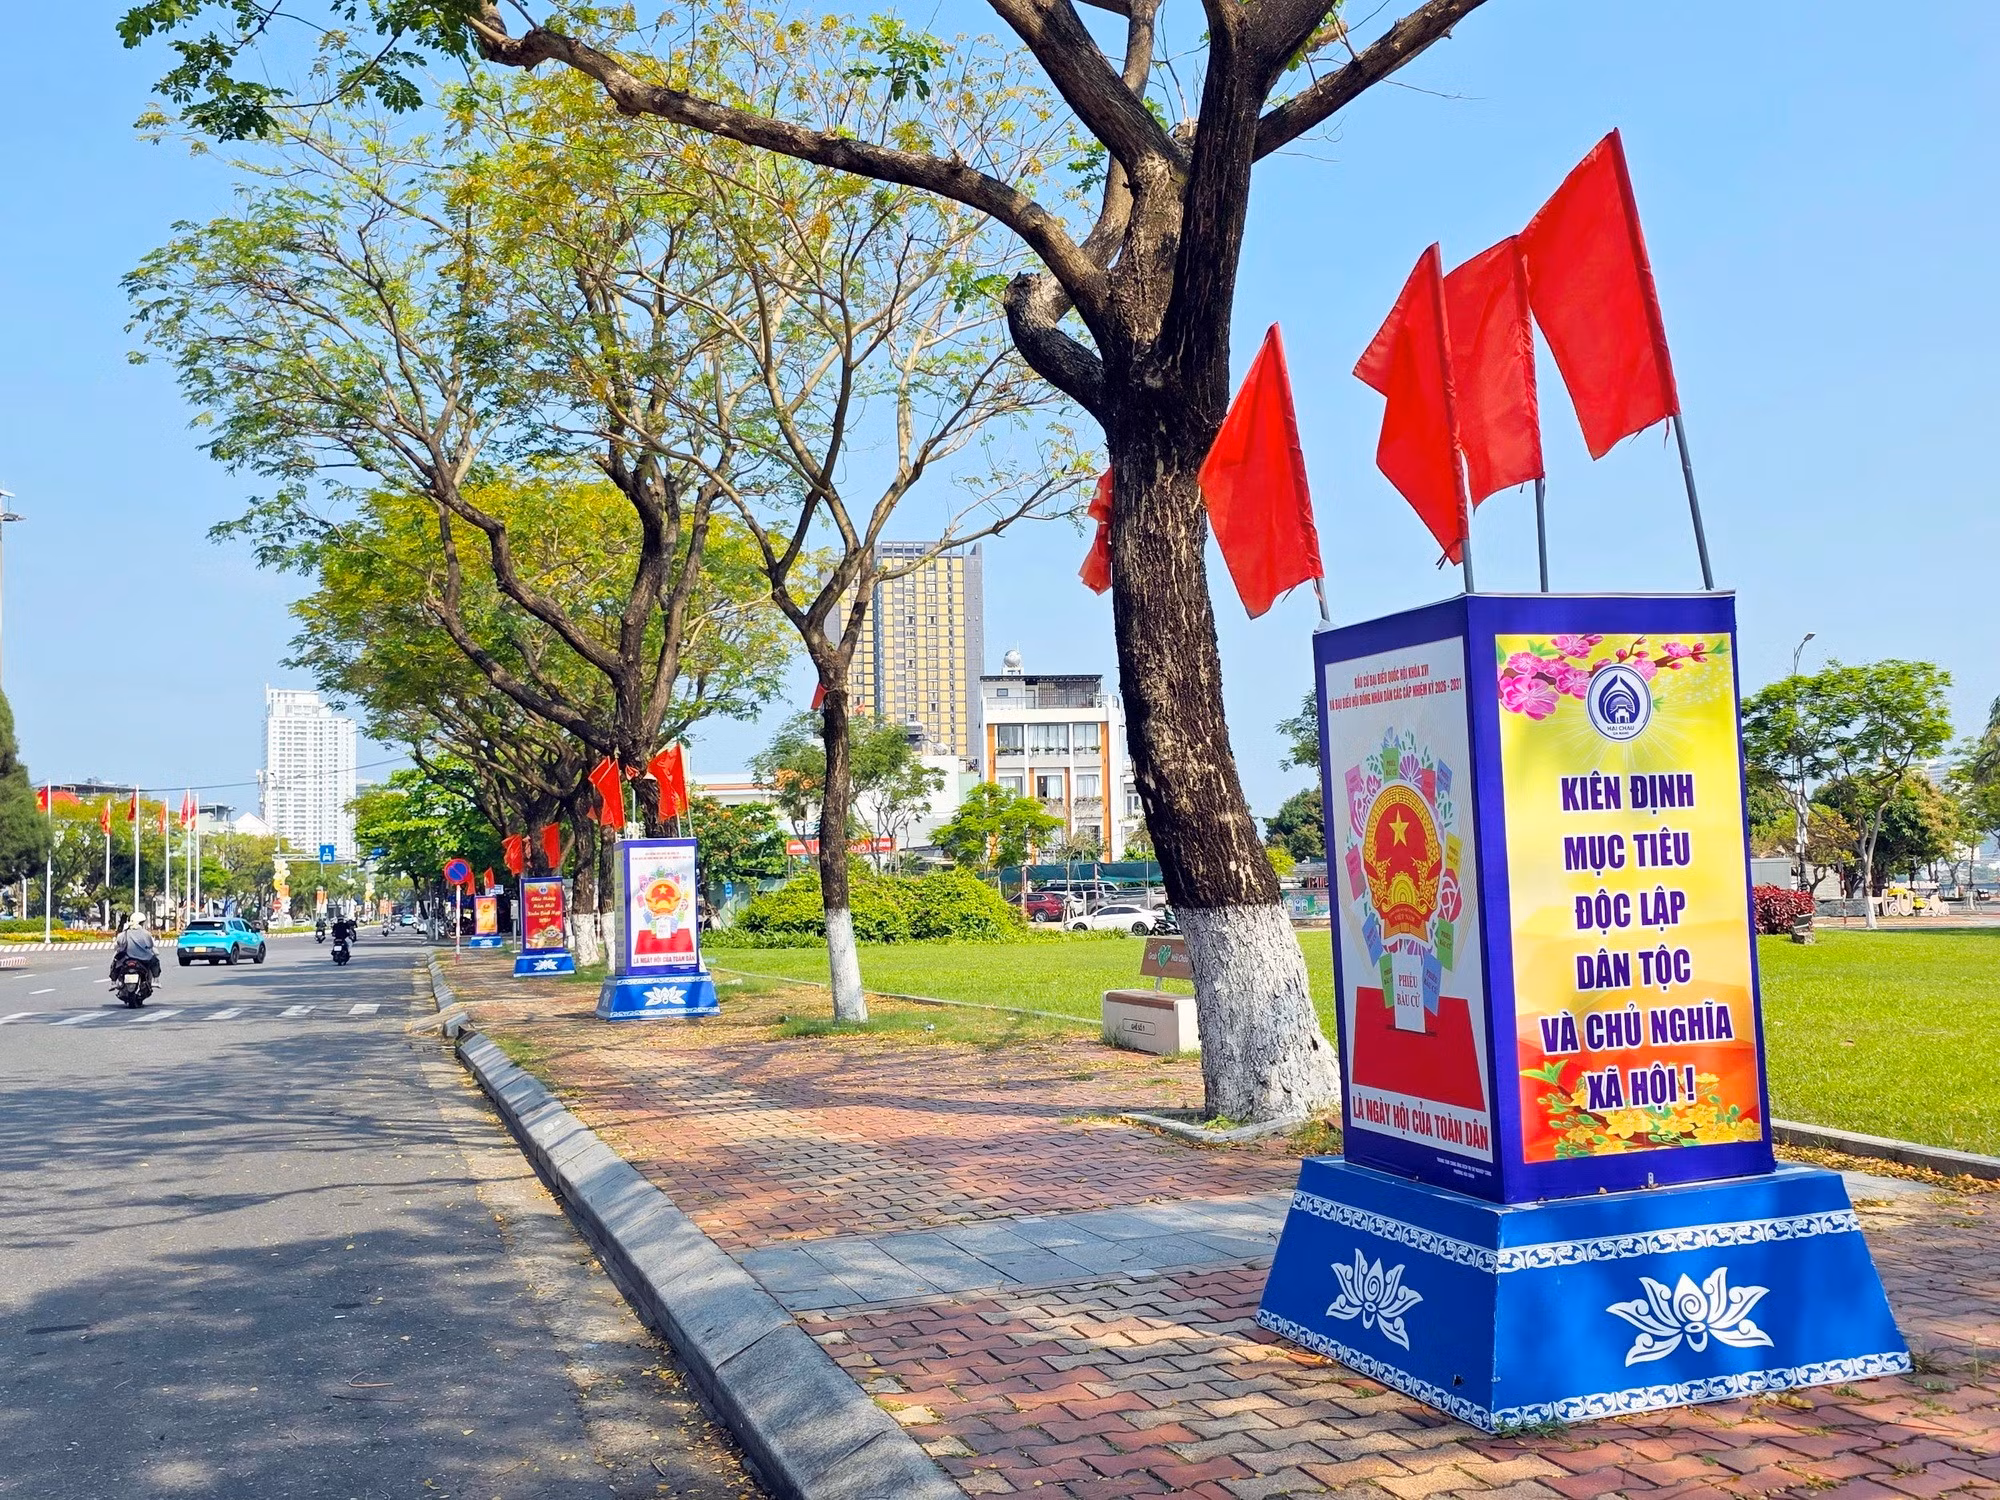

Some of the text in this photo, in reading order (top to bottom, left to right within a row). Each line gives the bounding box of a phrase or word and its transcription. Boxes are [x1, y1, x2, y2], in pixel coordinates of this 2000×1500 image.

[1561, 770, 1694, 815] KIÊN ĐỊNH
[1564, 827, 1690, 876] MỤC TIÊU
[1575, 886, 1686, 935] ĐỘC LẬP
[1399, 972, 1418, 988] PHIẾU
[1576, 944, 1690, 990] DÂN TỘC
[1541, 1001, 1733, 1052] VÀ CHỦ NGHĨA
[1587, 1064, 1694, 1110] XÃ HỘI !
[1353, 1092, 1489, 1151] LÀ NGÀY HỘI CỦA TOÀN DÂN
